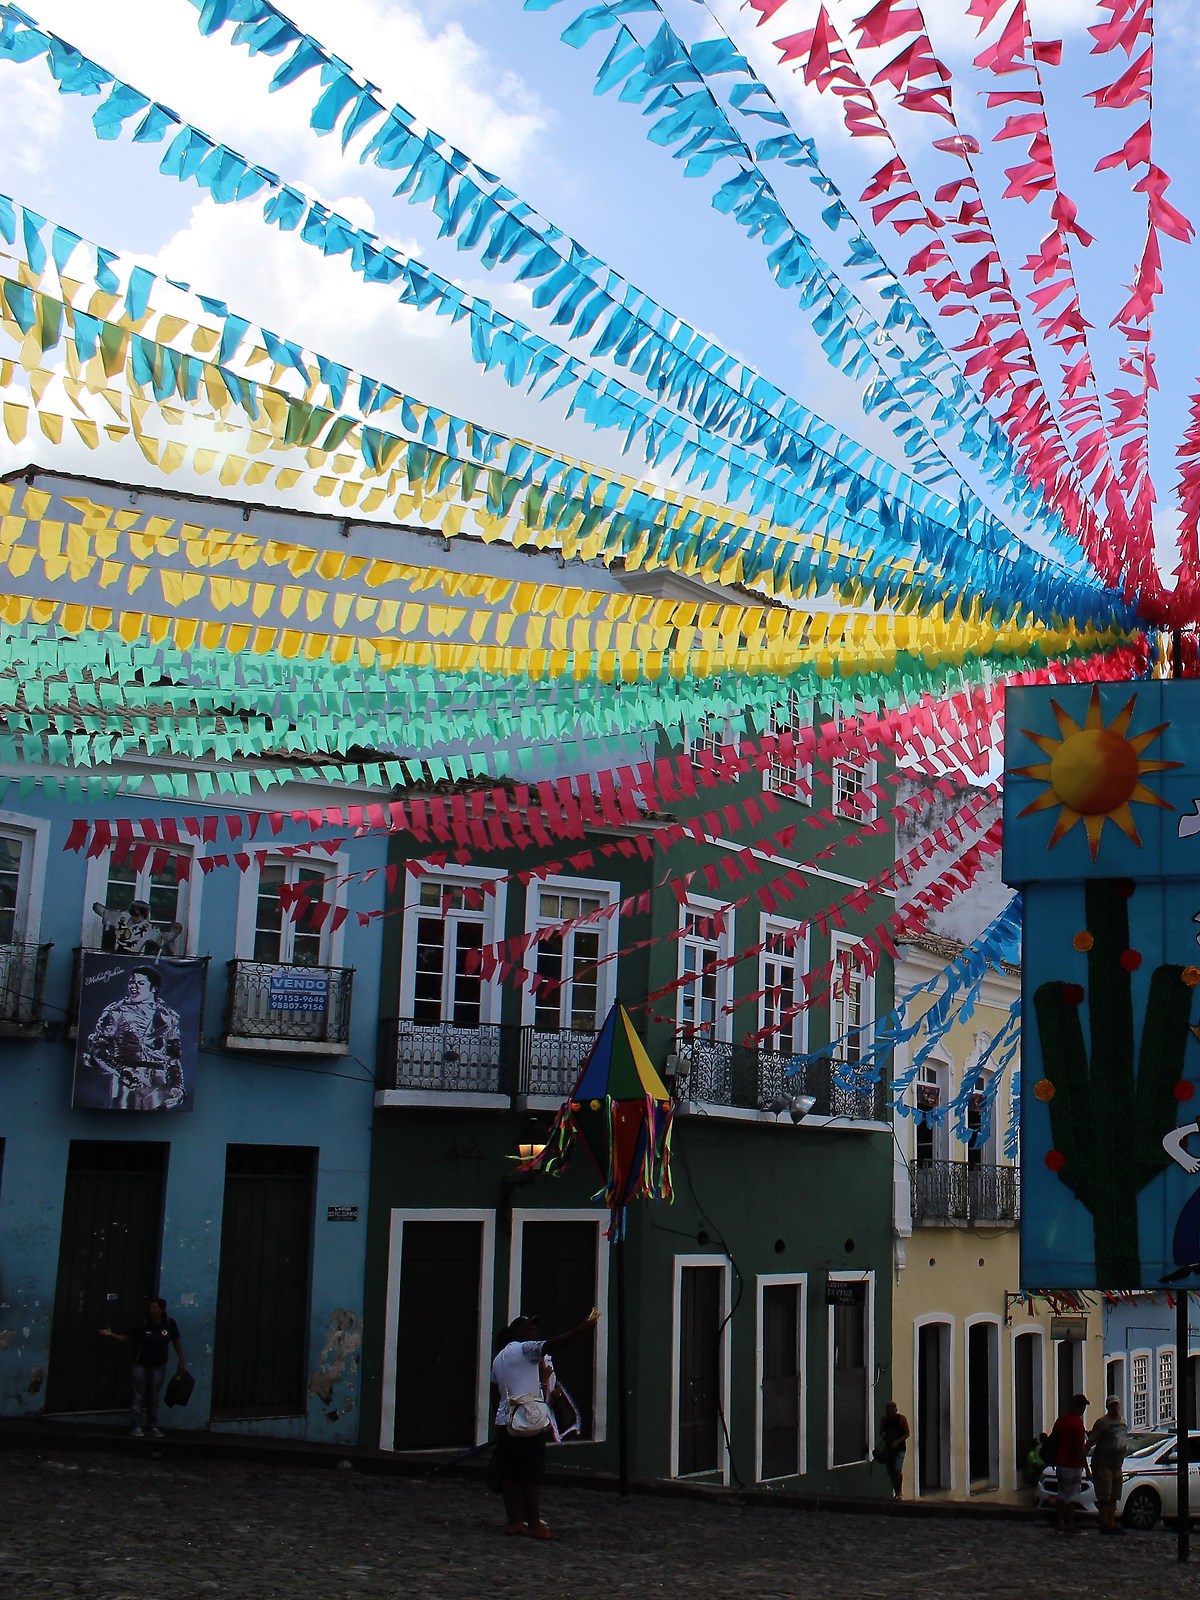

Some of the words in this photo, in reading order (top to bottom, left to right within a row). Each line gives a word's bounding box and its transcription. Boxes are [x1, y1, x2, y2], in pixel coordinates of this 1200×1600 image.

[273, 979, 326, 989] VENDO
[272, 994, 324, 1003] 99153-9646
[272, 1002, 323, 1011] 98807-9156
